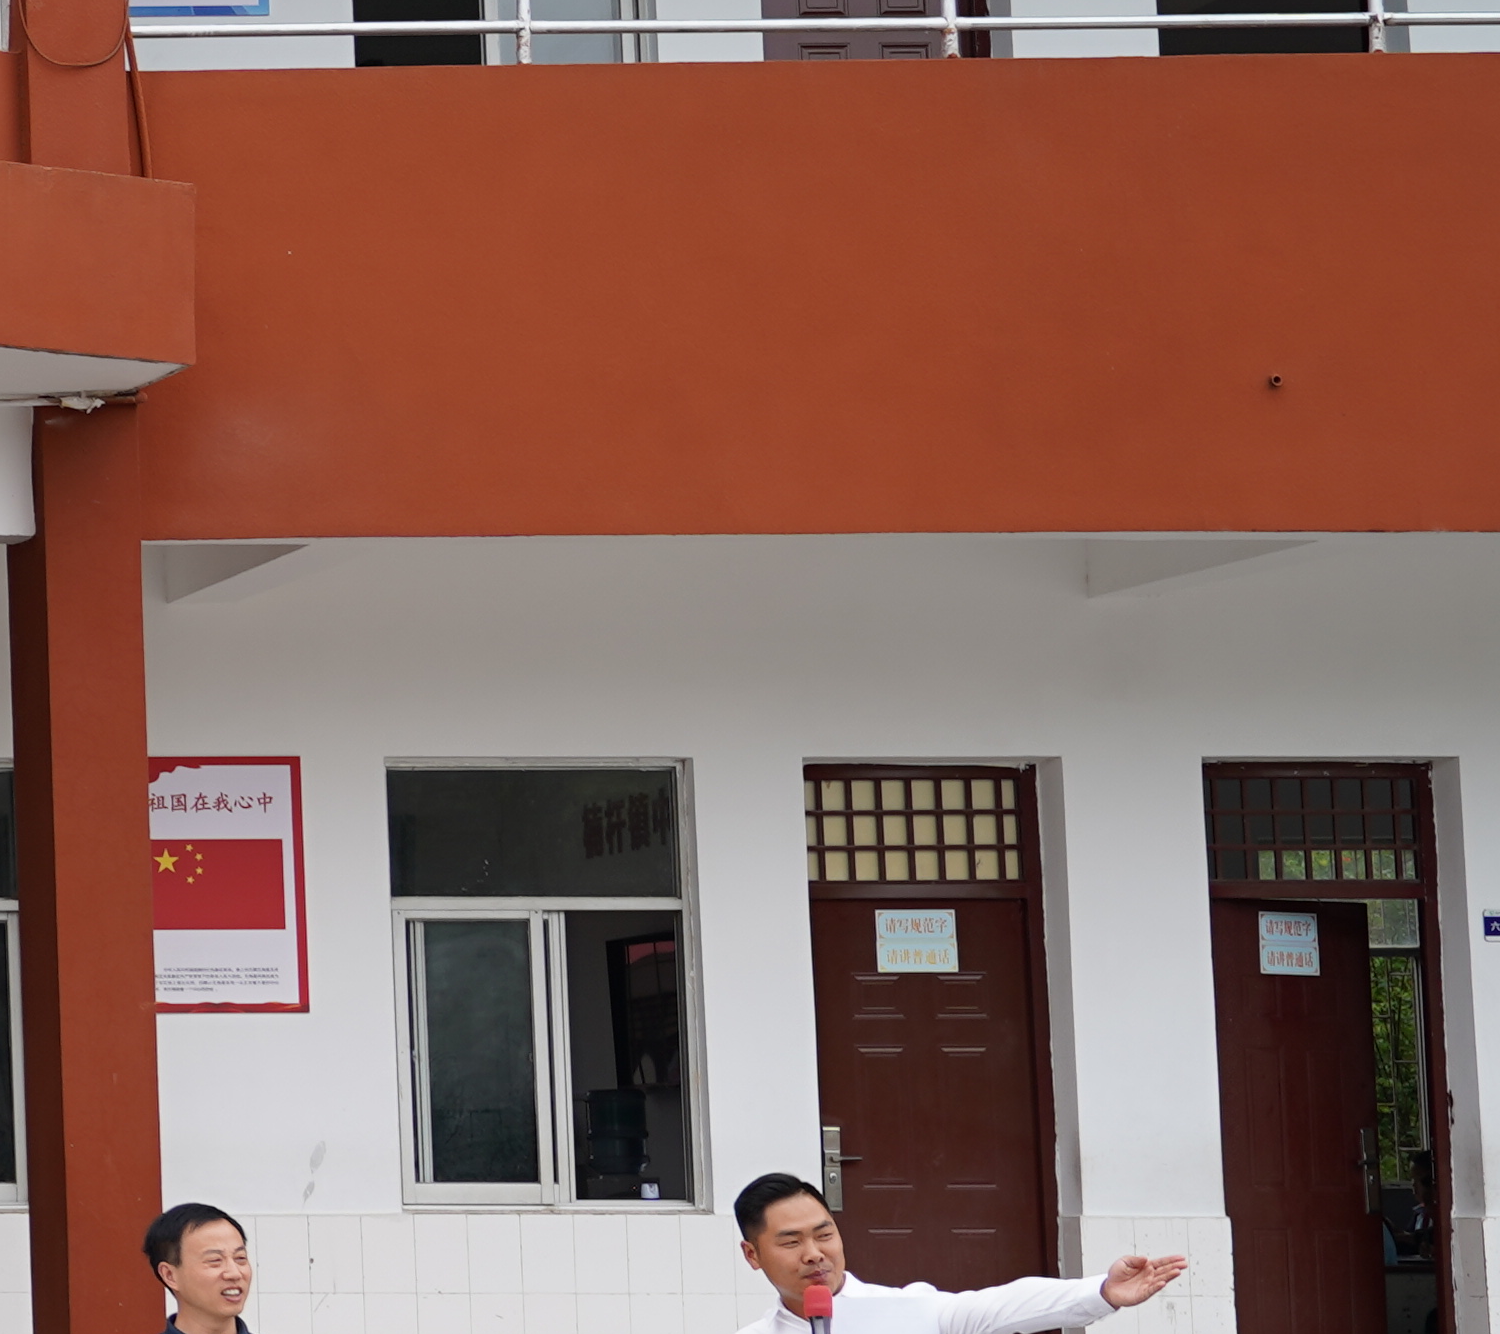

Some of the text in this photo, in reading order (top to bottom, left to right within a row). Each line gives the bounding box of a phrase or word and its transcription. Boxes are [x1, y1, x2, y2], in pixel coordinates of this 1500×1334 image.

[148, 790, 274, 814] 祖国在我心中
[884, 917, 948, 934] 请写规范字
[1265, 919, 1312, 937] 请写规范字
[886, 948, 950, 965] 请讲普通话
